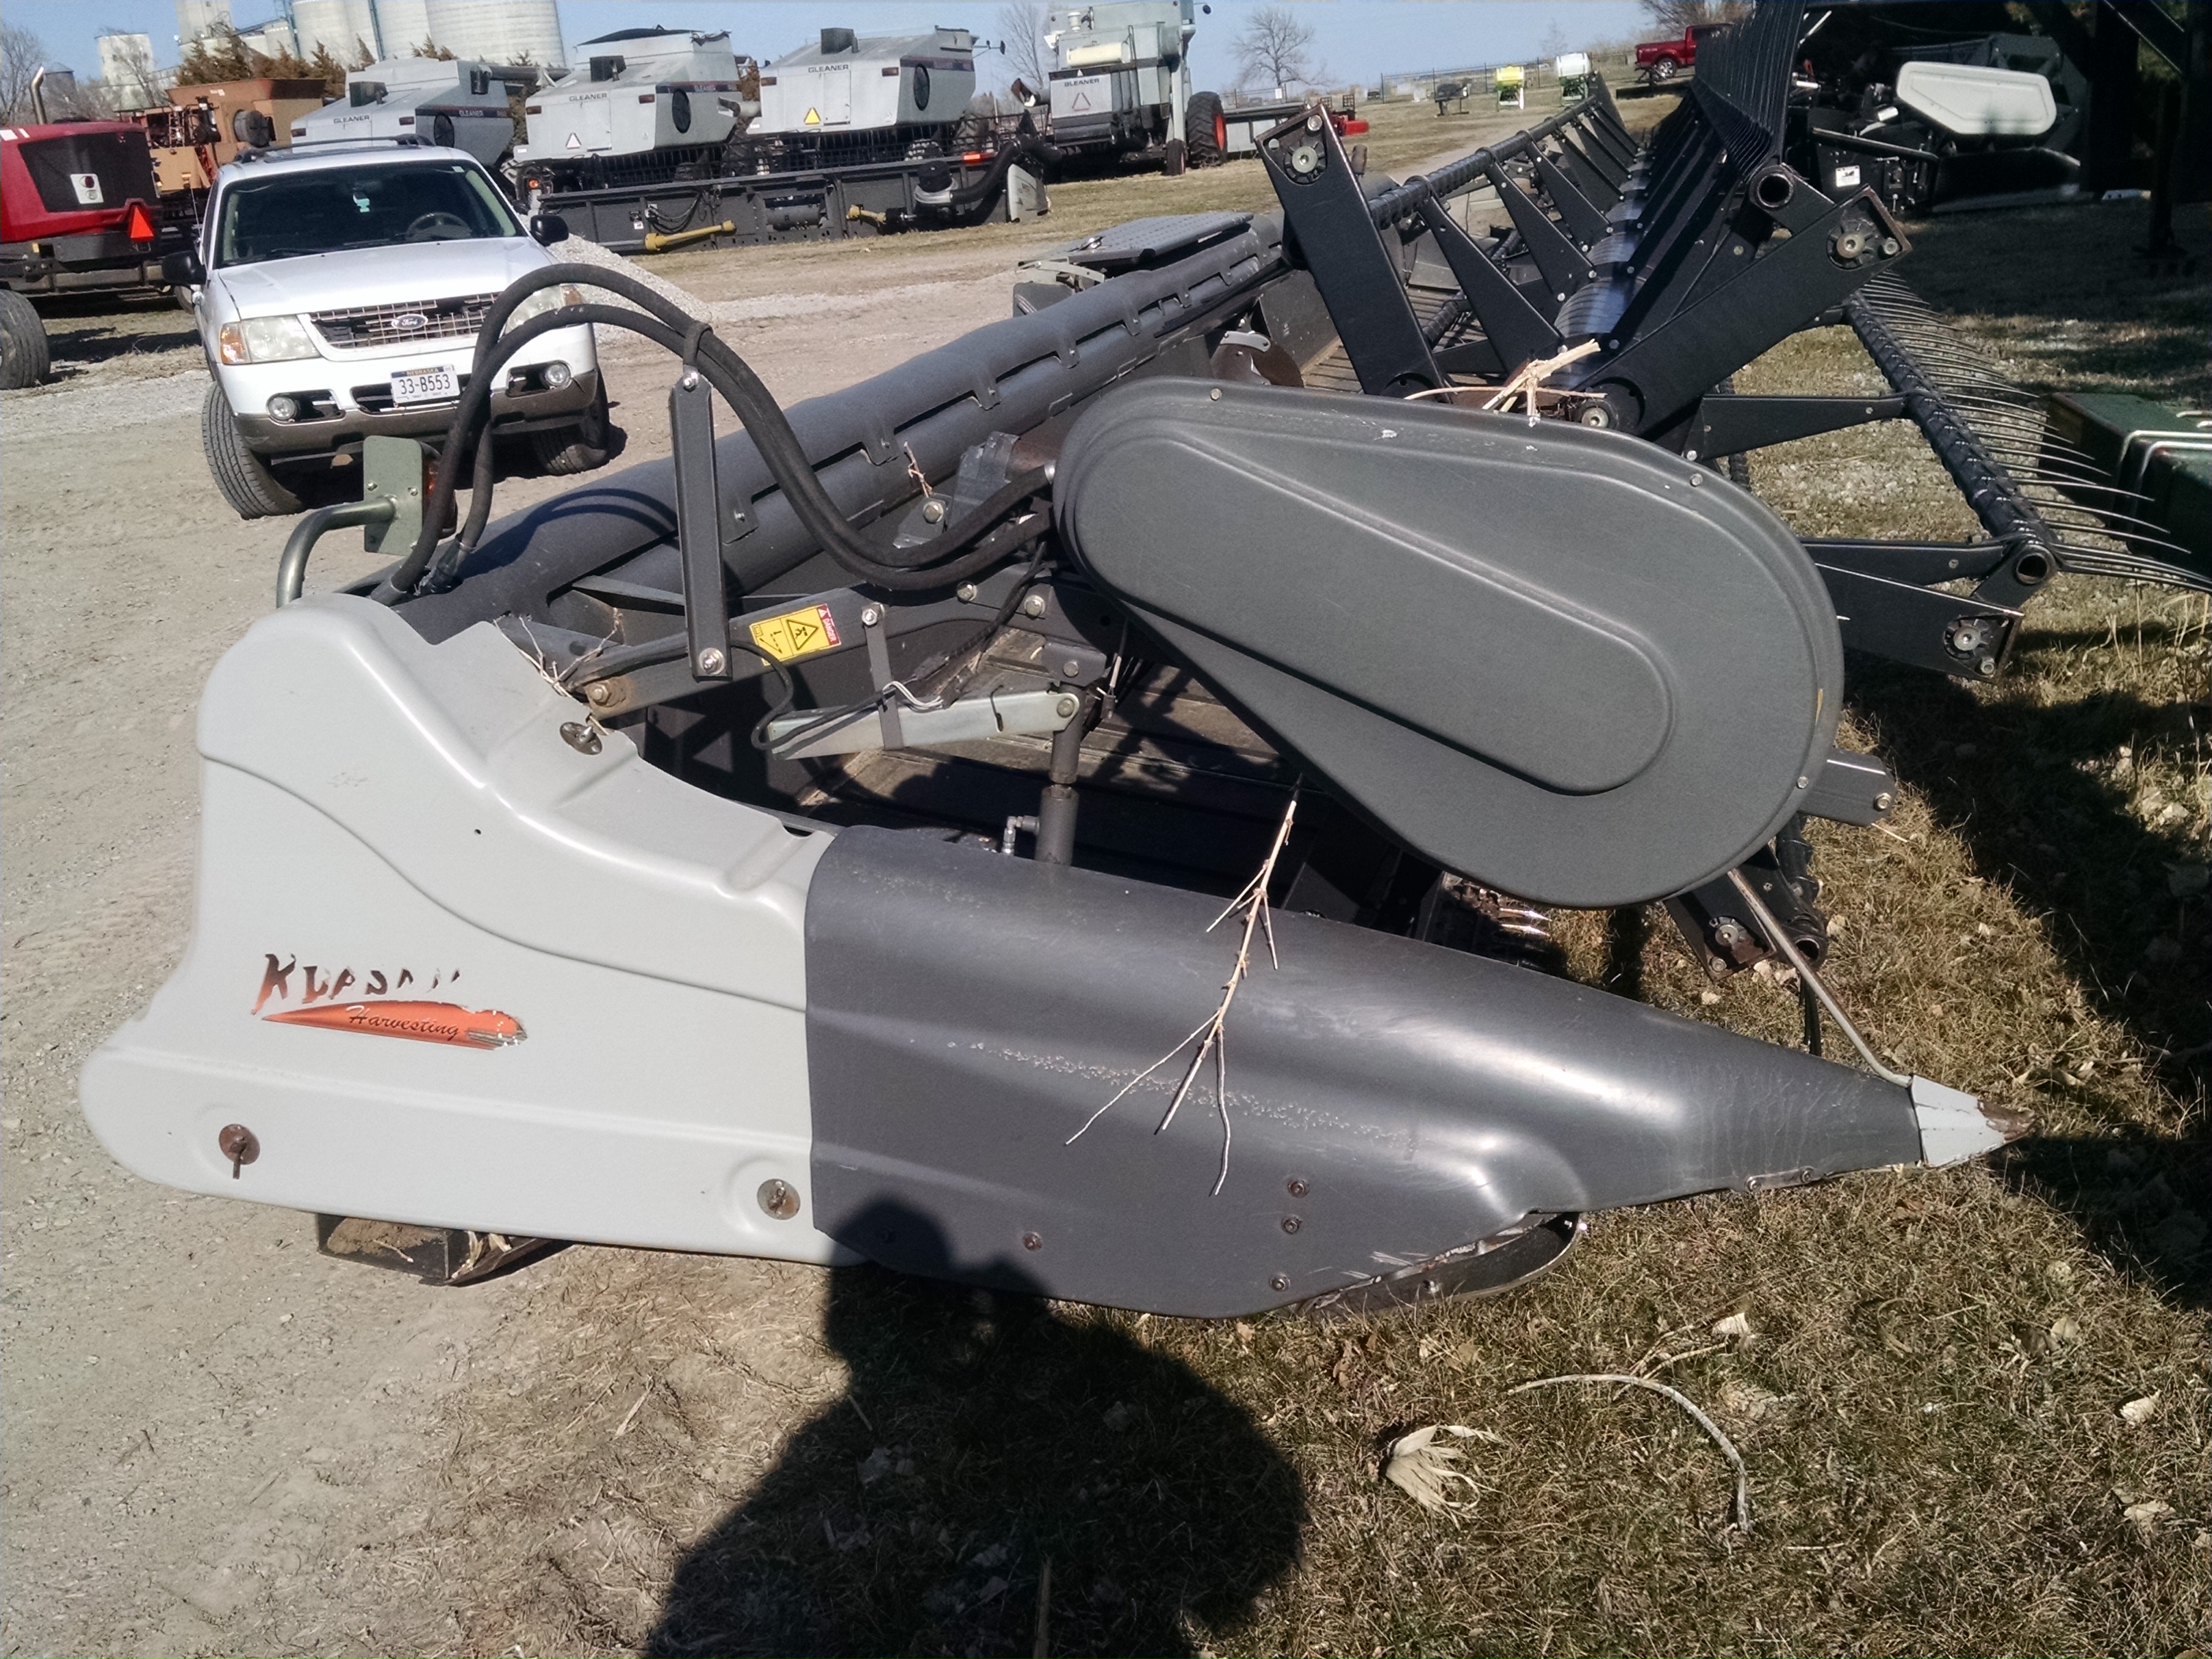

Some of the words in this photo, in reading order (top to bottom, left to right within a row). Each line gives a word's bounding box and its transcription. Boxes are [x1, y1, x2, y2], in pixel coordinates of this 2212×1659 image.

[808, 64, 849, 73] GLEANER
[1064, 78, 1100, 87] GLEANER
[569, 93, 607, 102] GLEANER
[333, 115, 370, 124] GLEANER
[407, 368, 438, 376] NEBRASKA
[822, 617, 836, 642] DANGER
[345, 1005, 460, 1041] Harvesting
